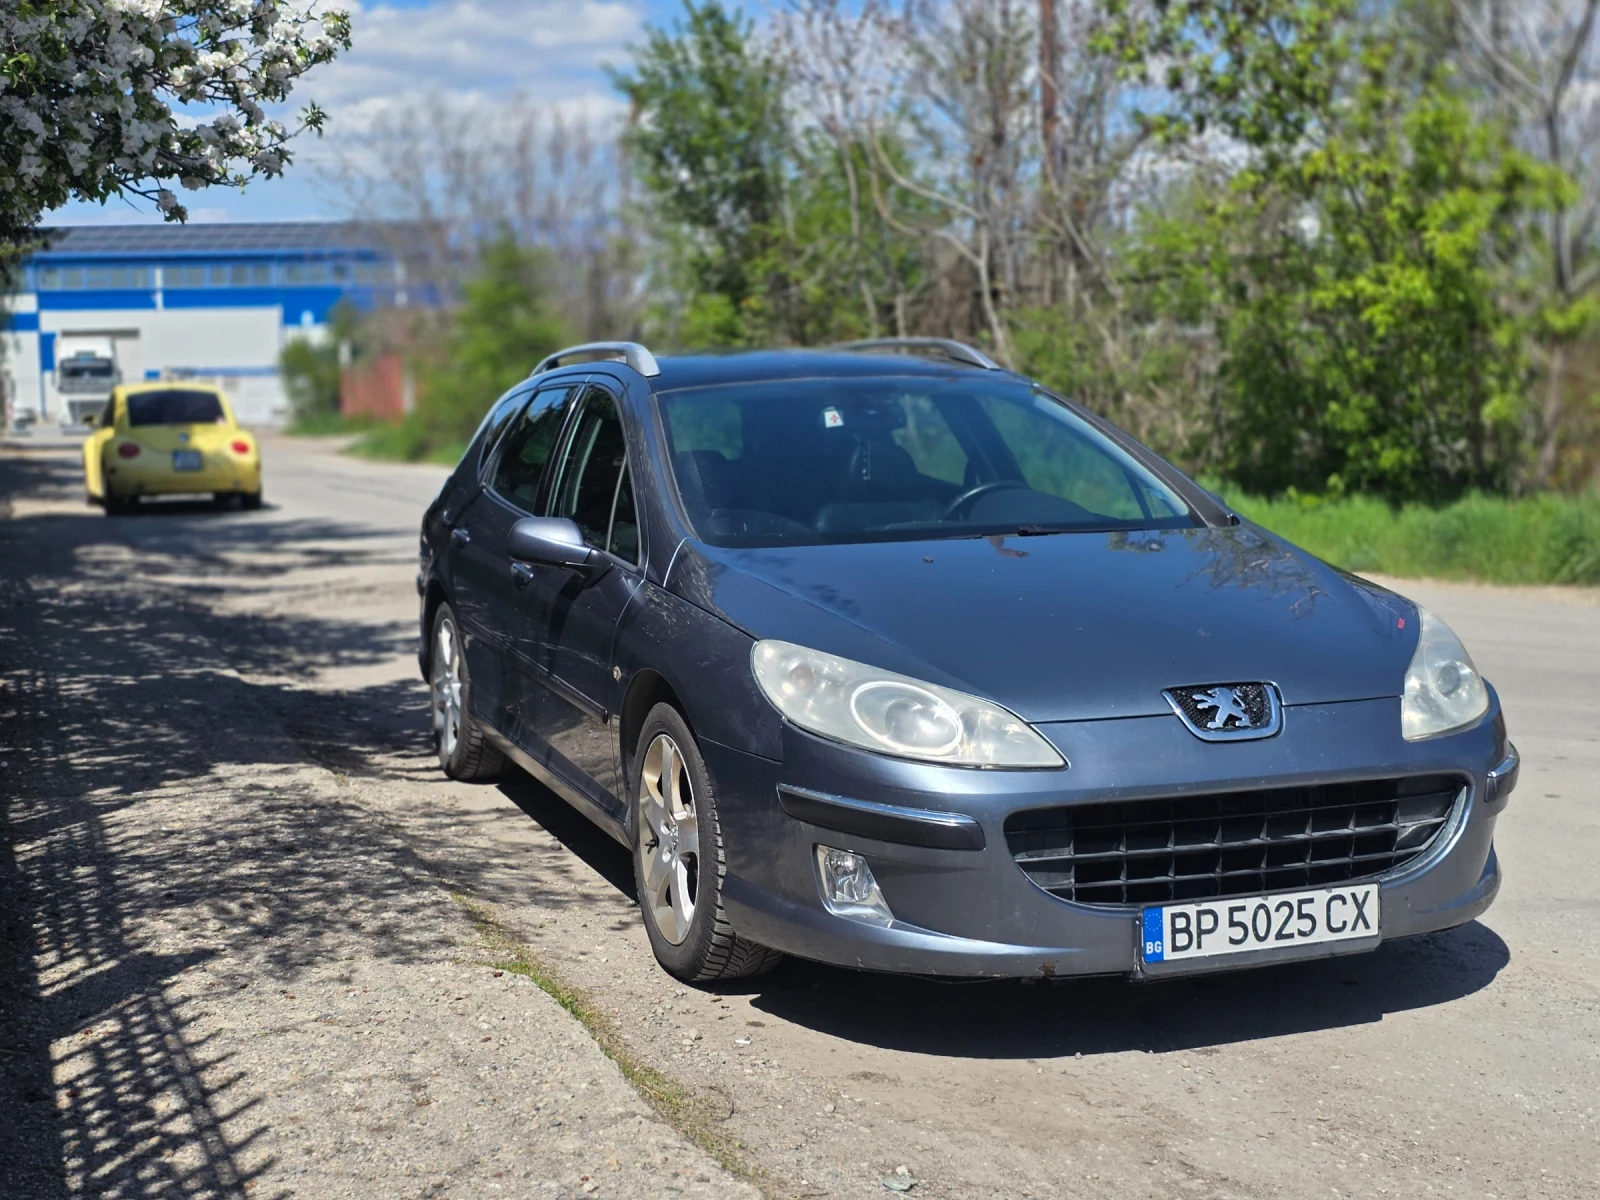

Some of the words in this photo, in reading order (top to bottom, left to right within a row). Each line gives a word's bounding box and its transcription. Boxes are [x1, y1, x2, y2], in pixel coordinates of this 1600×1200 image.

[1170, 908, 1219, 953] BP
[1228, 897, 1317, 945] 5025
[1325, 890, 1370, 934] CX
[1145, 940, 1162, 955] BG
